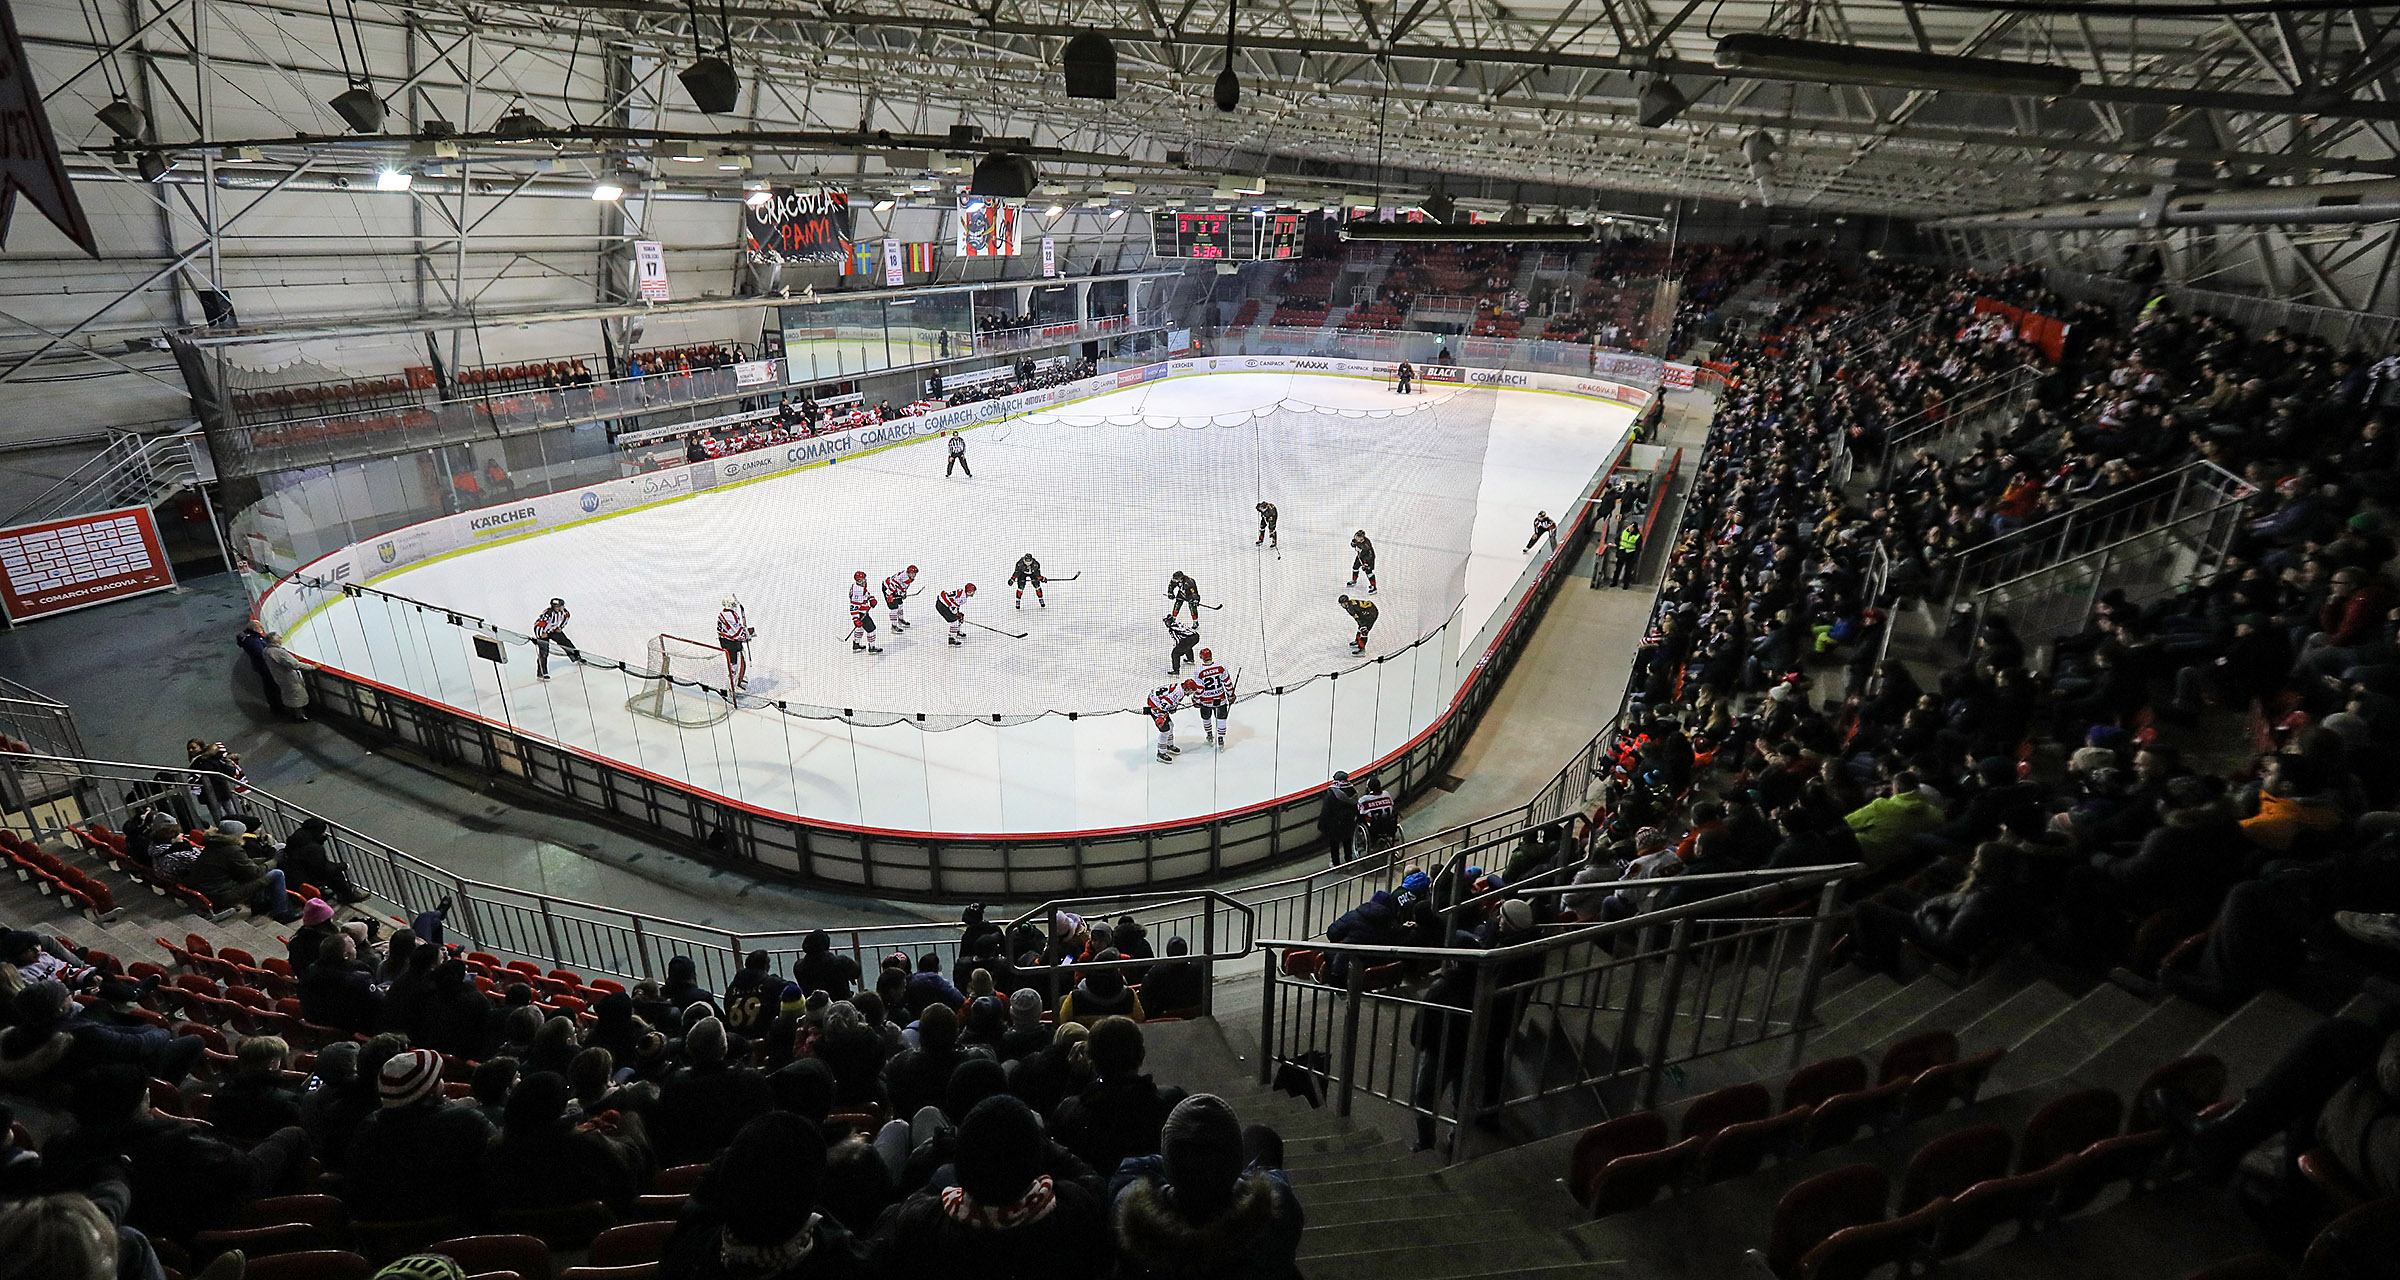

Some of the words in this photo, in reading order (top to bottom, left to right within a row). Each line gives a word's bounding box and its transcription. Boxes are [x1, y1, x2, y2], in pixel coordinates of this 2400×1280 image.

[756, 187, 837, 224] CRACOVIA
[782, 217, 831, 251] PANY!
[1180, 221, 1187, 233] 3
[1212, 222, 1220, 233] 2
[646, 262, 657, 276] 17
[890, 255, 898, 267] 18
[1296, 361, 1329, 370] MAXXX
[1427, 367, 1457, 377] BLACK
[1470, 372, 1528, 385] COMARCH
[980, 399, 1023, 417] COMARCH
[925, 409, 972, 430] COMARCH
[860, 422, 915, 445] COMARCH
[787, 437, 851, 462] COMARCH
[742, 458, 772, 471] CANPACK
[660, 474, 688, 490] AJP
[581, 497, 598, 509] my
[470, 507, 536, 530] KÄRCHER
[295, 562, 350, 601] TRUE
[39, 589, 89, 604] COMARCH
[90, 578, 138, 593] CRACOVIA
[1204, 676, 1224, 691] 21
[729, 997, 761, 1027] 69
